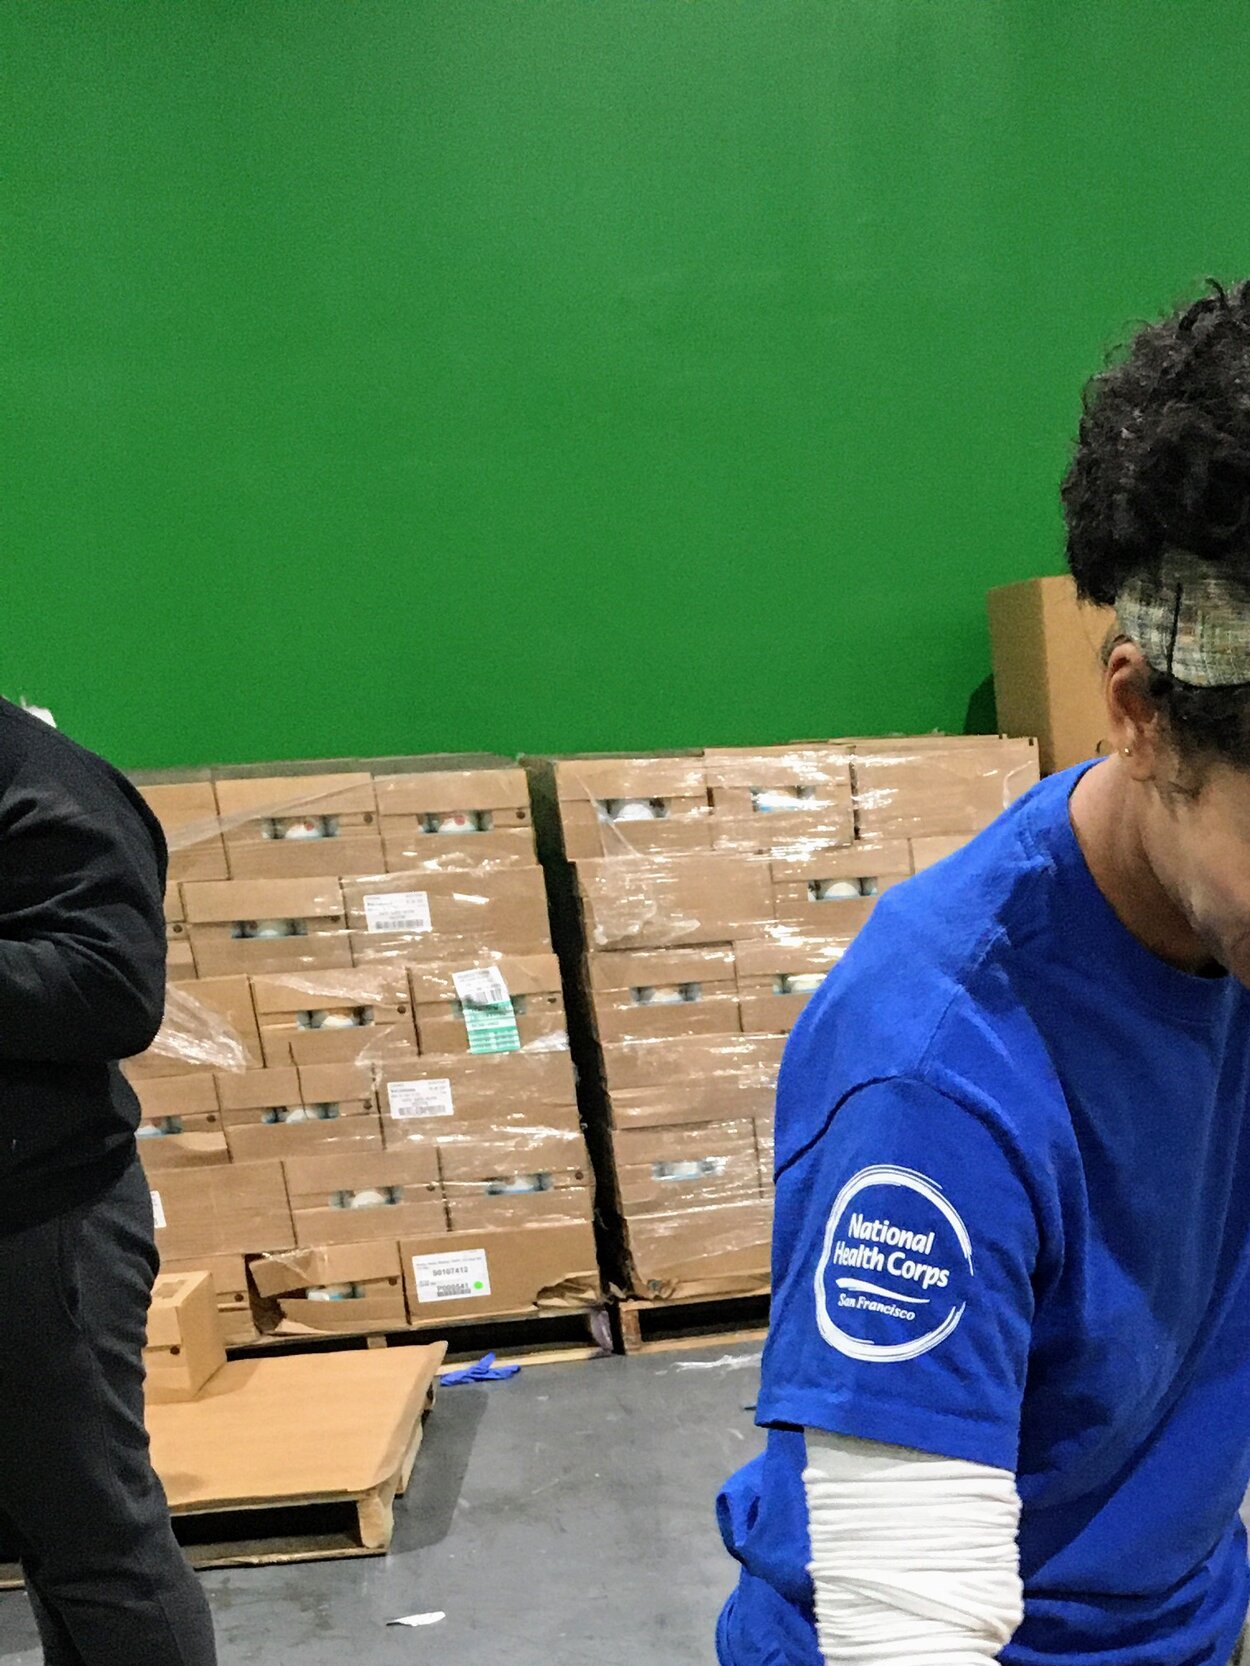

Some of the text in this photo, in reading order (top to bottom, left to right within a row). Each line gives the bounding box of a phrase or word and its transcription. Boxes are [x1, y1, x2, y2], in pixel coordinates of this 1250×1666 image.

[848, 1213, 935, 1255] National
[833, 1241, 950, 1289] Health Corps
[838, 1293, 916, 1321] San Francisco
